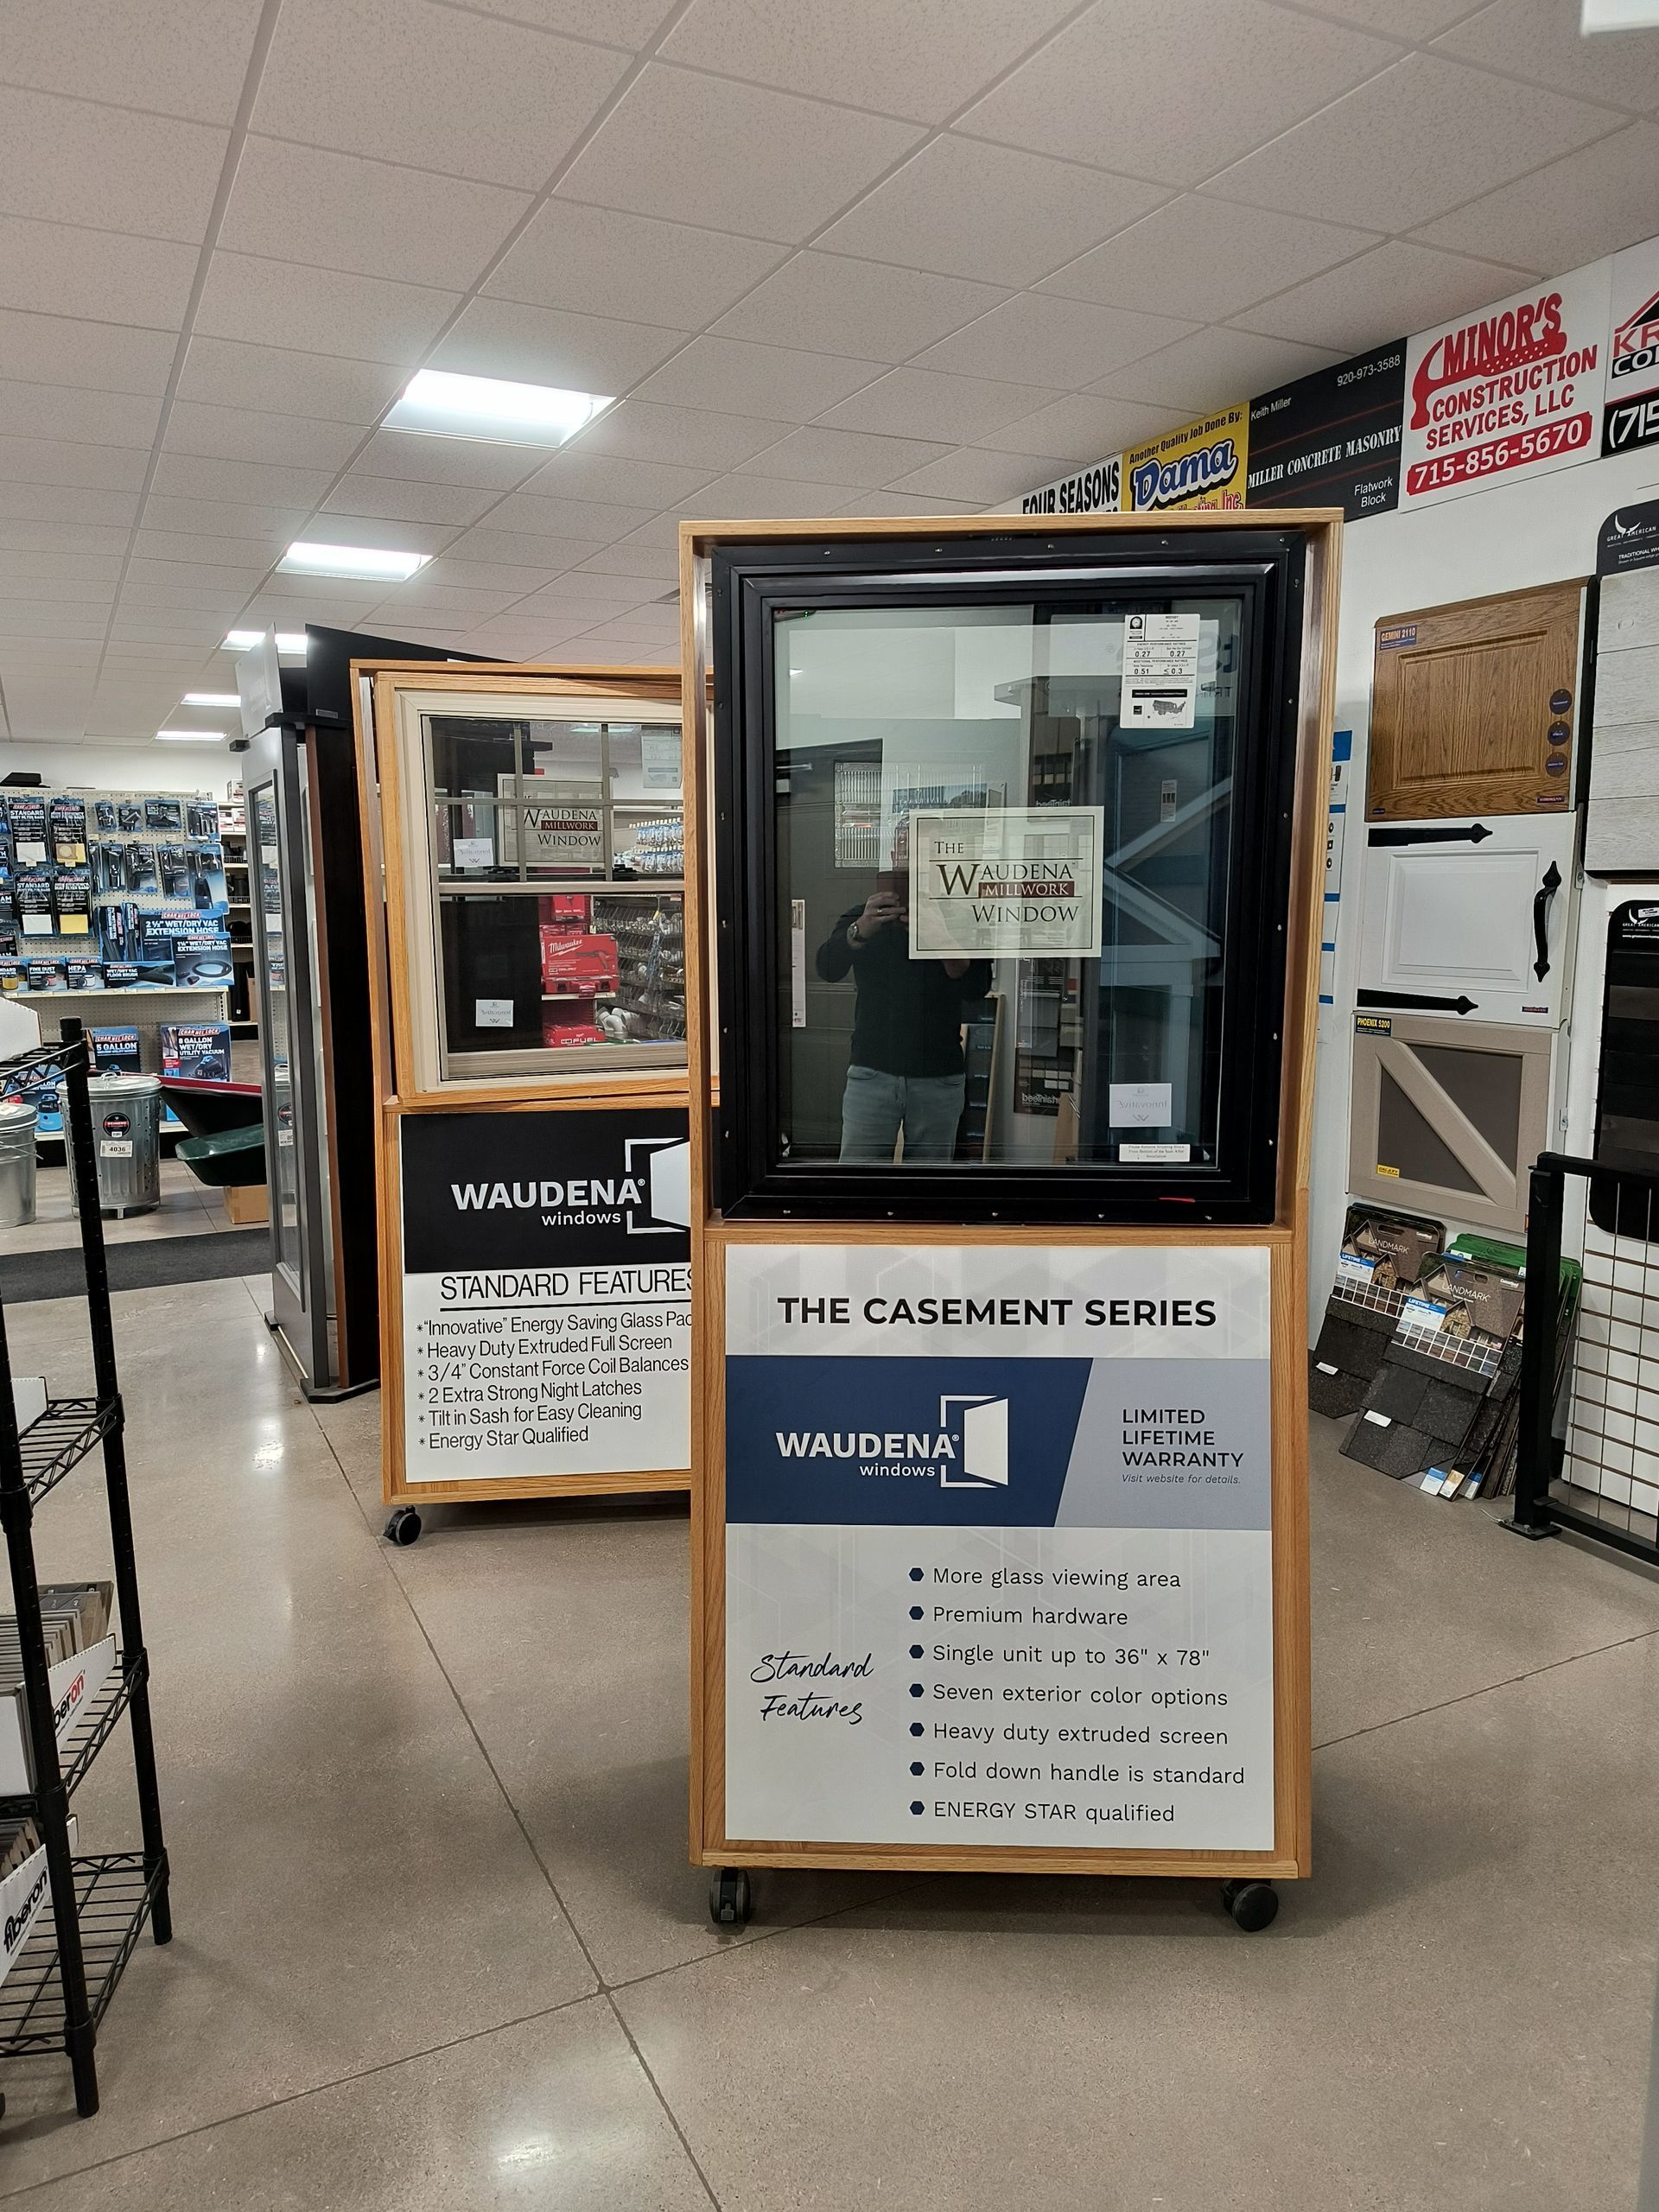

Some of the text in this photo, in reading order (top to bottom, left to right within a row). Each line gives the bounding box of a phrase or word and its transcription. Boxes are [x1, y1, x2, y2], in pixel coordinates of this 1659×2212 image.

[1443, 293, 1562, 378] MINOR'S
[1337, 354, 1401, 386] 920-973-3588
[1433, 345, 1598, 423] CONSTRUCTION
[1250, 397, 1292, 421] Keith Miller
[1426, 384, 1575, 450] SERVICES, LLC
[1129, 410, 1243, 465] Another Quality Job Done By:
[1247, 425, 1402, 490] MILLER CONCRETE MASONRY
[1414, 419, 1583, 489] 715-856-5670
[1133, 439, 1237, 509] Dama
[1023, 461, 1119, 514] FOUR SEASONS
[1354, 476, 1394, 496] Flatwork
[1361, 492, 1387, 508] Block
[1628, 526, 1656, 537] AMERICAN
[1618, 549, 1650, 560] TRADITIONAL
[1382, 627, 1416, 642] GEMINI 2110
[537, 833, 601, 846] WINDOW
[934, 841, 964, 854] THE
[936, 862, 1074, 895] WAUDENA
[984, 883, 1069, 896] MILLWORK
[971, 905, 1079, 923] WINDOW
[145, 927, 196, 936] EXTENSION
[548, 938, 582, 954] Milwaukee
[1357, 1017, 1391, 1028] PHOENIX 5200
[541, 1211, 621, 1226] windows
[1368, 1236, 1408, 1254] LANDMARK
[441, 1273, 569, 1300] STANDARD
[1441, 1282, 1490, 1302] LANDMARK
[778, 1296, 1217, 1327] THE CASEMENT SERIES
[511, 1316, 563, 1335] Energy
[567, 1313, 618, 1332] Saving
[620, 1313, 664, 1329] Glass
[427, 1334, 672, 1360] Heavy Duty Extruded Full Screen
[469, 1361, 539, 1379] Constant
[542, 1360, 585, 1376] Force
[588, 1357, 616, 1374] Coil
[619, 1357, 689, 1373] Balances
[428, 1380, 642, 1403] 2 Extra Strong Night Latches
[428, 1402, 642, 1427] Tilt in Sash for Easy Cleaning
[1122, 1408, 1206, 1425] LIMITED
[429, 1426, 589, 1451] Energy Star Qualified
[1122, 1430, 1216, 1446] LIFETIME
[859, 1463, 936, 1478] windows
[1122, 1451, 1244, 1468] WARRANTY
[1122, 1473, 1242, 1484] Visit website for details.
[932, 1567, 1181, 1591] More glass viewing area
[932, 1605, 1128, 1626] Premium hardware
[750, 1650, 875, 1683] Standard
[932, 1644, 1211, 1669] Single unit up to 36" x 78"
[932, 1684, 1229, 1710] Seven exterior color options
[760, 1692, 864, 1725] Features
[933, 1722, 1229, 1745] Heavy duty extruded screen
[933, 1762, 1246, 1784] Fold down handle is standard
[933, 1801, 1175, 1822] ENERGY STAR qualified
[3, 1870, 48, 1954] fiberon
